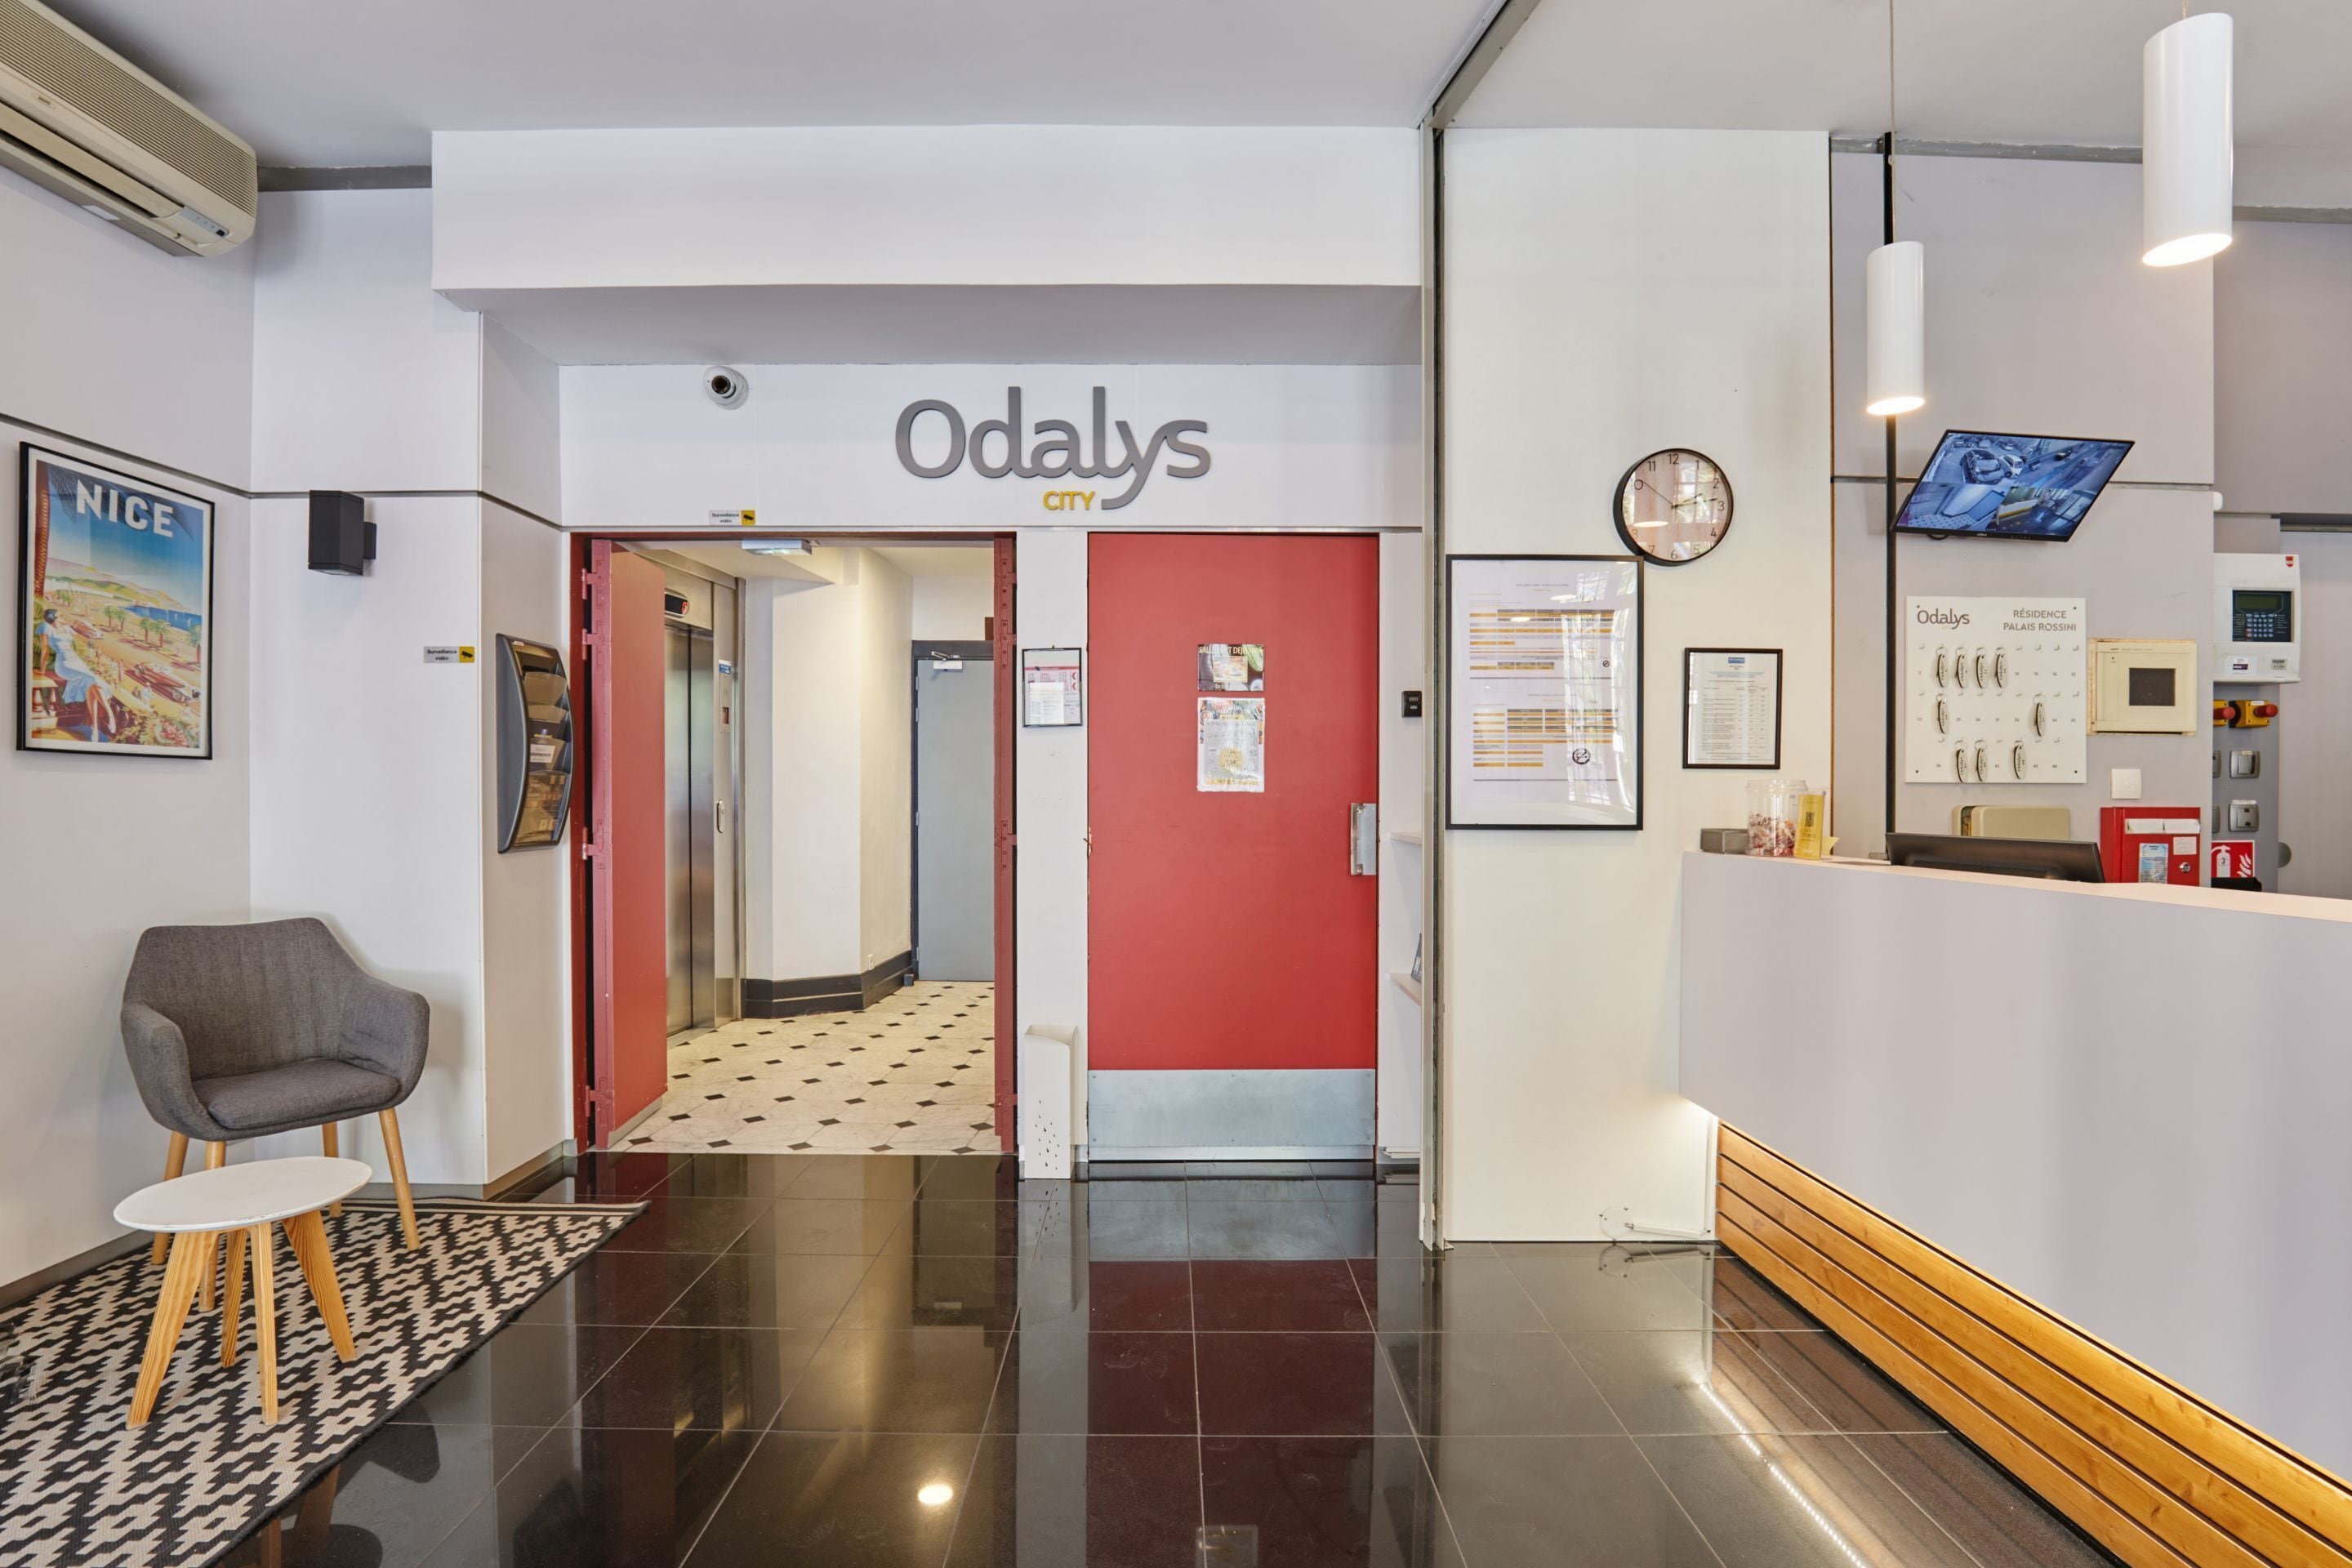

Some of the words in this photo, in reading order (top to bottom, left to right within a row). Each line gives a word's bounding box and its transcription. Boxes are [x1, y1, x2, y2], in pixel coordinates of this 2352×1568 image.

[895, 386, 1211, 510] Odalys
[1668, 453, 1679, 465] 12
[1647, 461, 1656, 472] 11
[1695, 460, 1699, 471] 1
[1713, 478, 1719, 489] 2
[1043, 491, 1095, 510] CITY
[1718, 501, 1725, 511] 3
[77, 479, 173, 537] NICE
[1711, 528, 1717, 537] 4
[1648, 546, 1655, 555] 7
[1671, 550, 1678, 559] 6
[1693, 545, 1699, 555] 5
[2013, 608, 2067, 618] RÉSIDENCE
[1917, 608, 1970, 630] Odalys
[2003, 622, 2035, 630] PALAIS
[2038, 623, 2076, 631] ROSSINI
